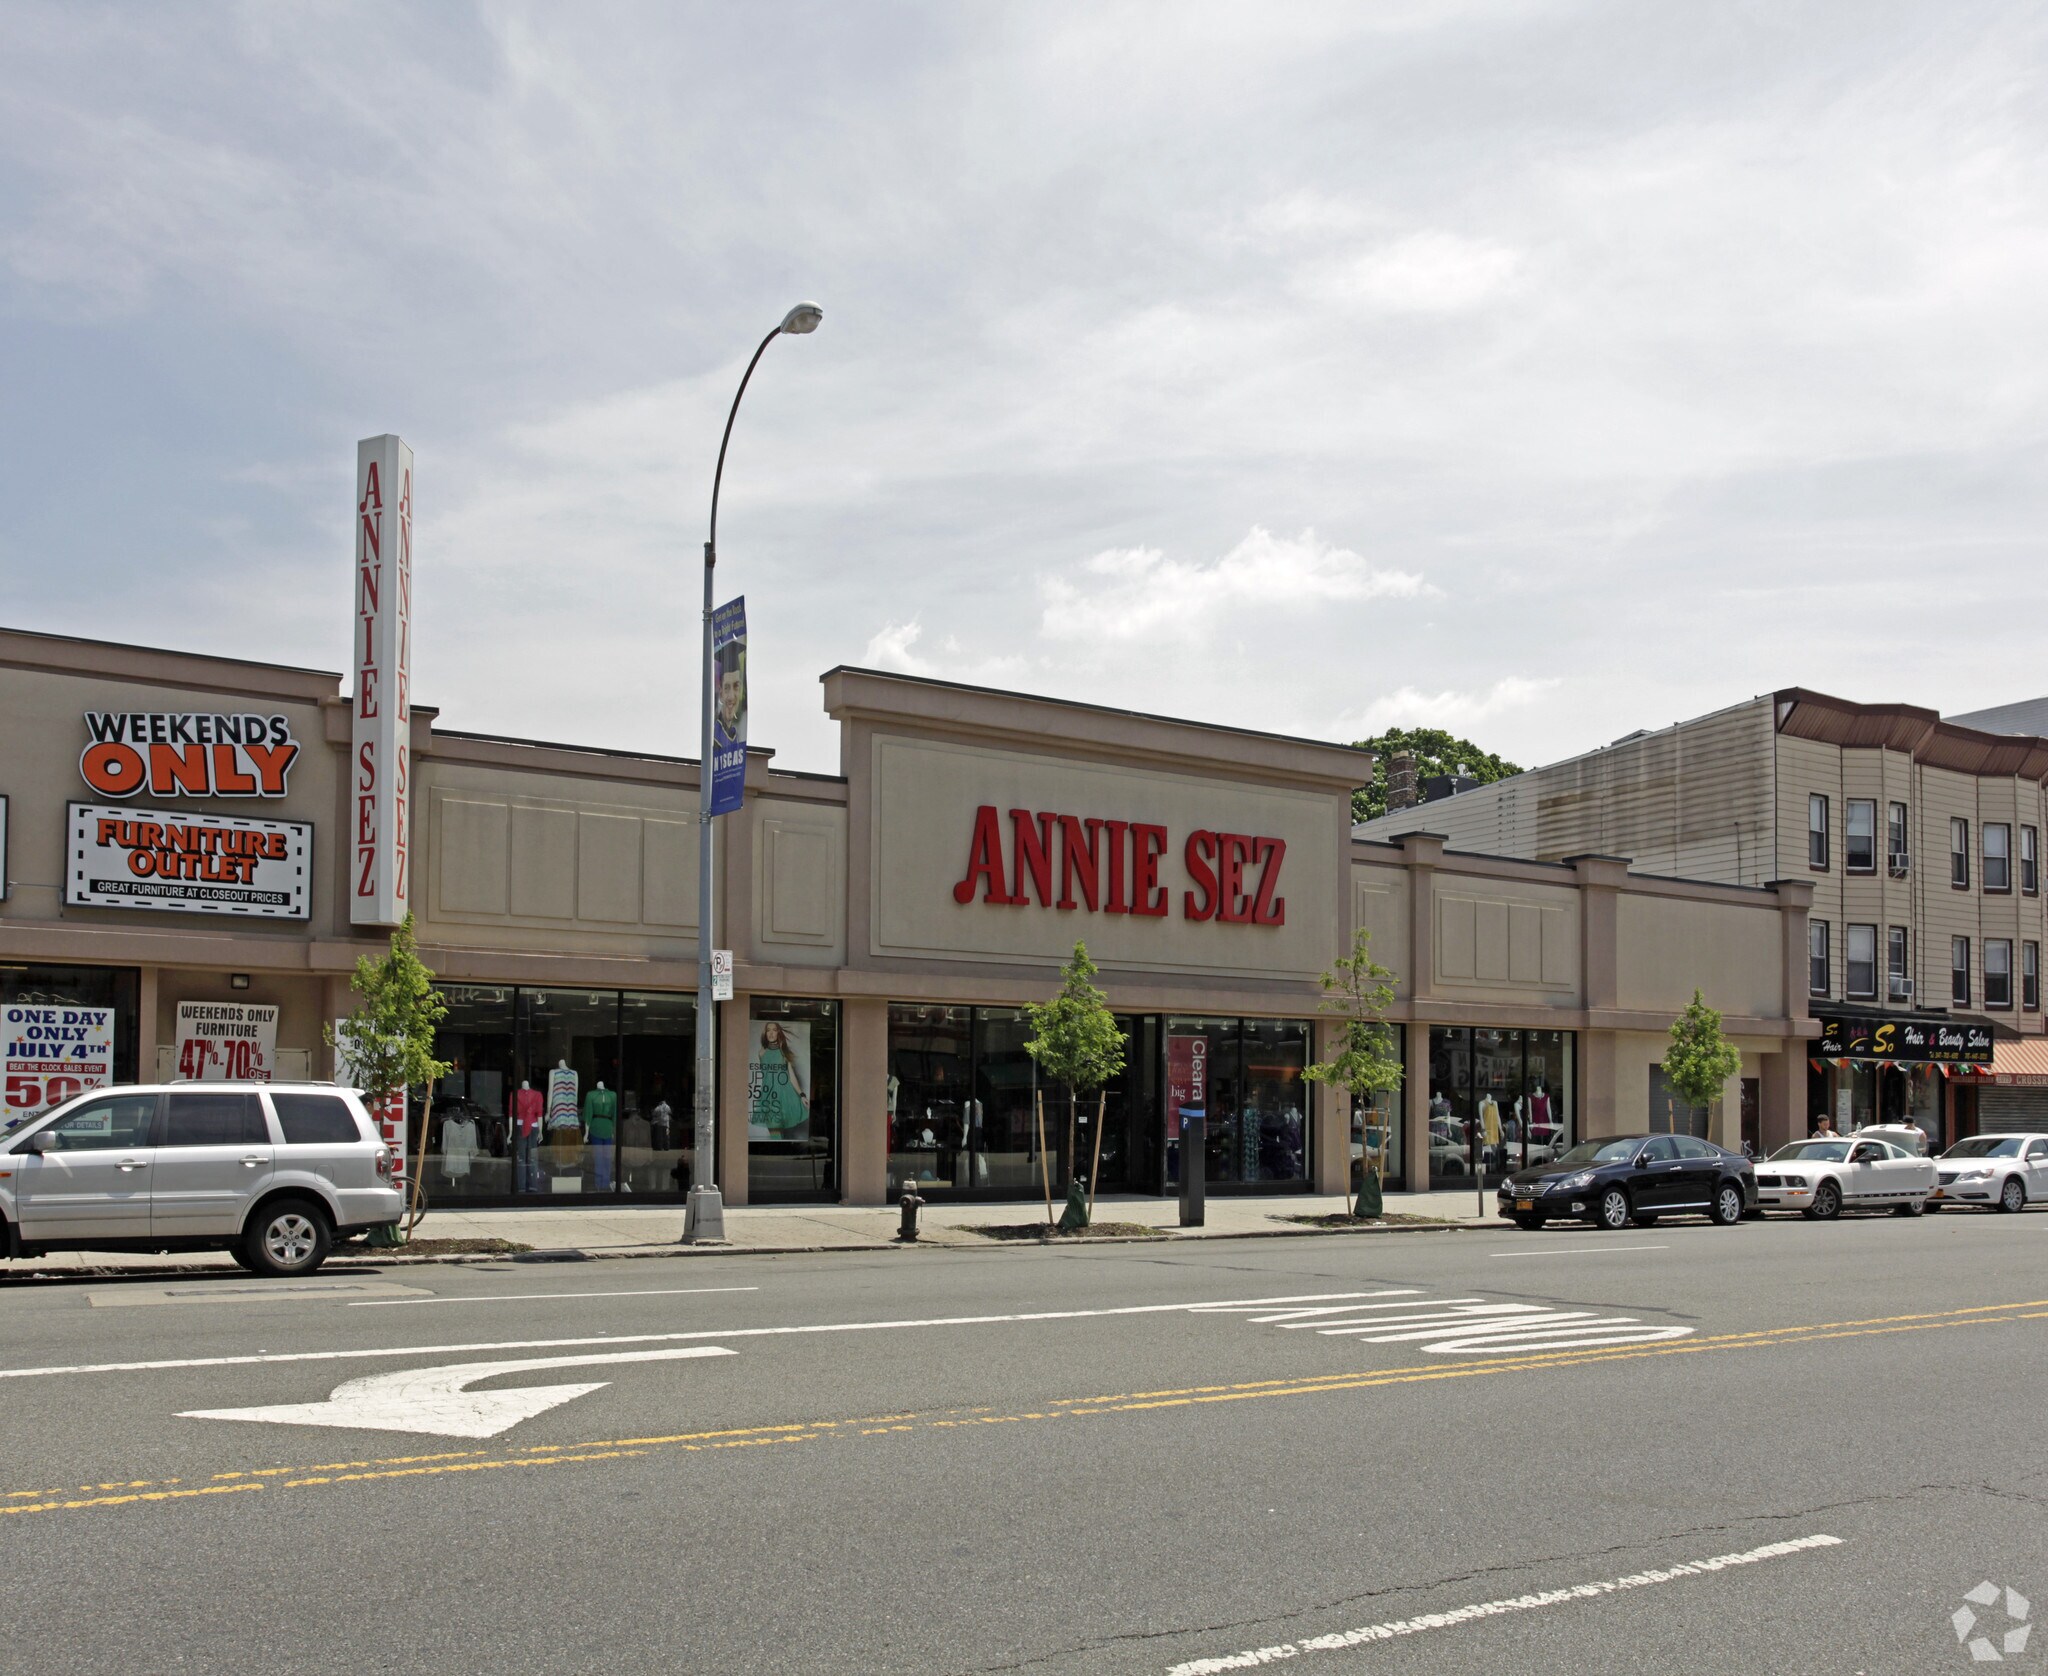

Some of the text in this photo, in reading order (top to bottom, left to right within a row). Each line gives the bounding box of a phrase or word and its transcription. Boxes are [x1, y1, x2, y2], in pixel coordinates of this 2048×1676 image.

[358, 462, 382, 897] ANNIE SEZ
[396, 468, 411, 900] ANNIE SEZ
[87, 713, 288, 744] WEEKENDS
[82, 742, 298, 794] ONLY
[96, 818, 288, 861] FURNITURE
[127, 848, 258, 885] OUTLET
[953, 805, 1287, 926] ANNIE SEZ
[97, 881, 283, 904] GREAT FURNITURE AT CLOSEOUT PRICES
[7, 1009, 107, 1026] ONE DAY
[181, 1006, 275, 1022] WEEKENDS ONLY
[26, 1026, 88, 1041] ONLY
[196, 1022, 258, 1037] FURNITURE
[1822, 1040, 1842, 1052] Hair
[1873, 1024, 1895, 1053] So
[1905, 1026, 1925, 1045] Hair
[1929, 1033, 1936, 1046] &
[1939, 1027, 1964, 1051] Beauty
[1967, 1029, 1990, 1047] Salon
[6, 1042, 107, 1059] JULY 4TH
[9, 1063, 103, 1073] BEAT THE CLOCK SALES EVENT
[768, 1071, 789, 1086] TO
[1171, 1085, 1186, 1101] big
[748, 1100, 781, 1114] ESS
[76, 1121, 102, 1129] DETAILS
